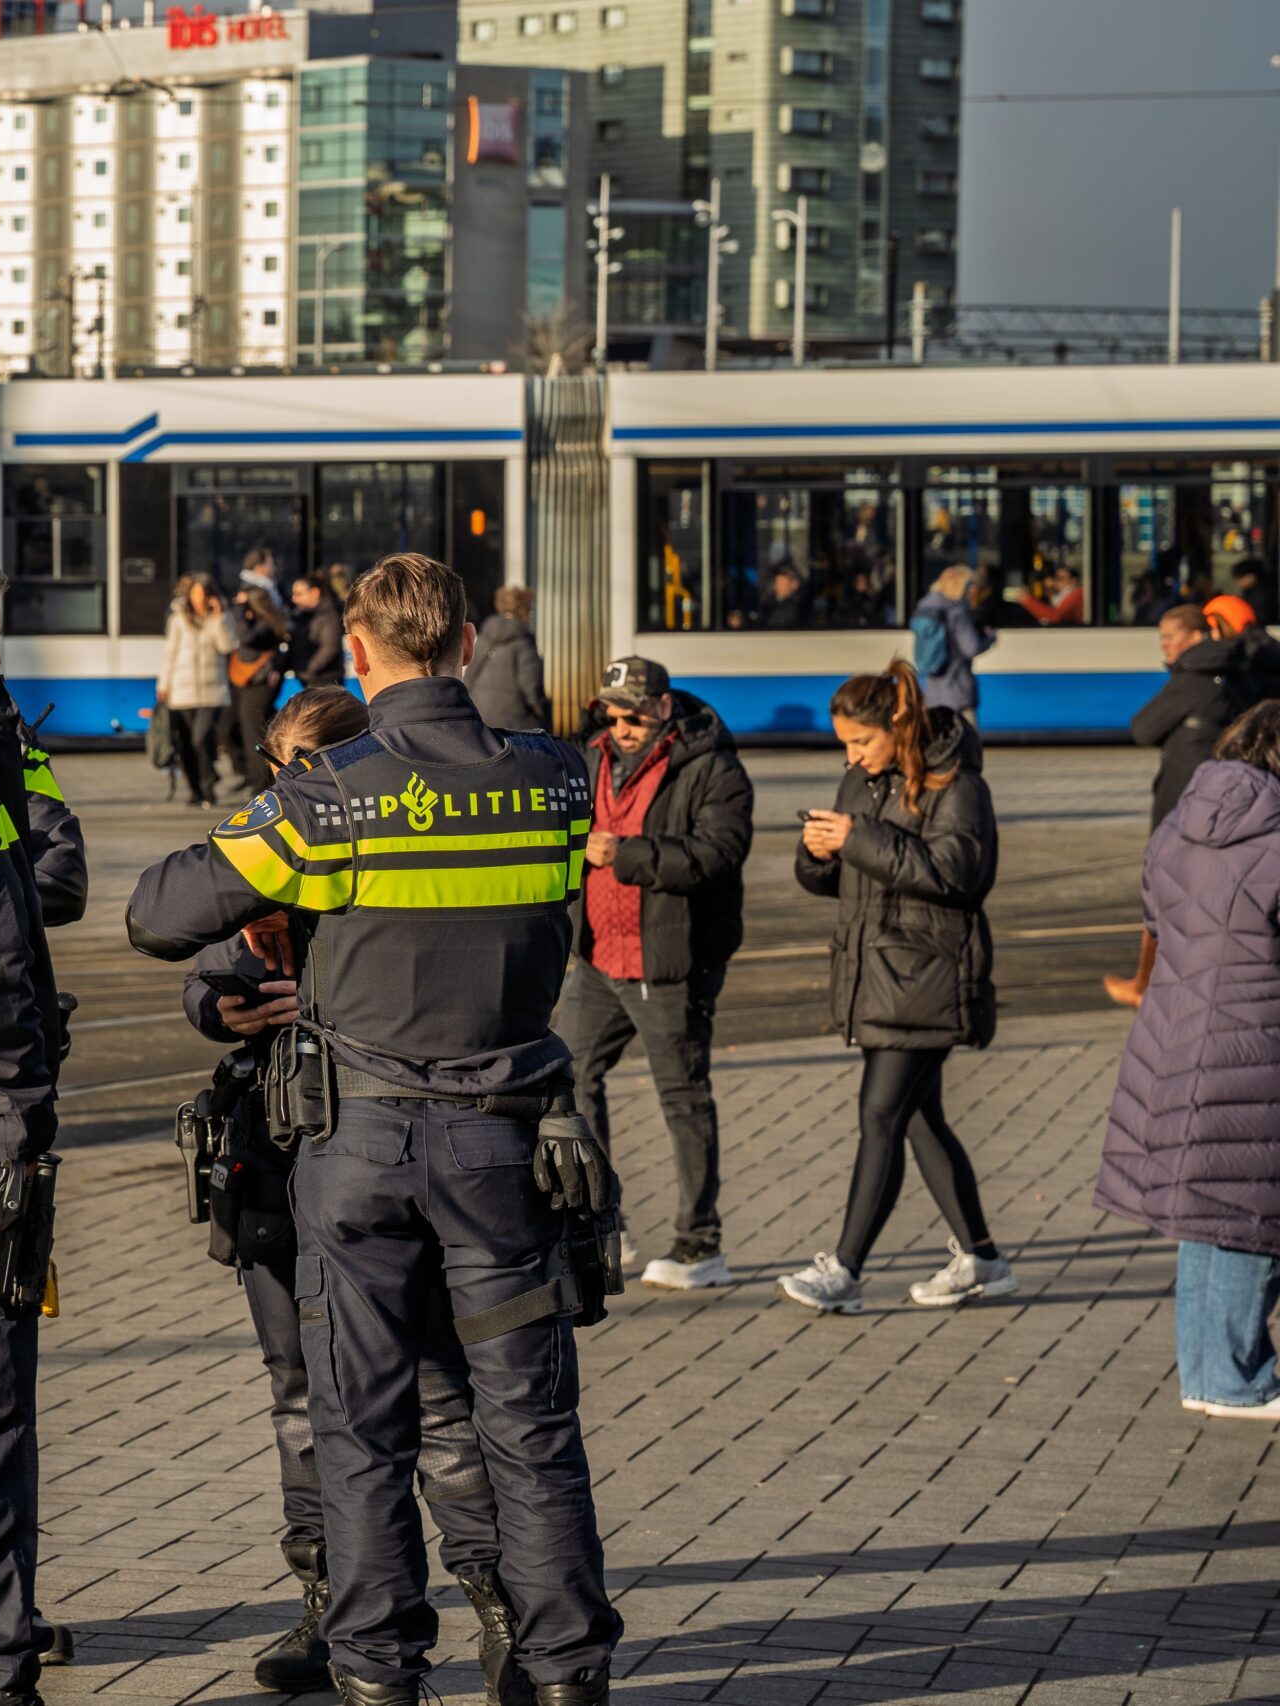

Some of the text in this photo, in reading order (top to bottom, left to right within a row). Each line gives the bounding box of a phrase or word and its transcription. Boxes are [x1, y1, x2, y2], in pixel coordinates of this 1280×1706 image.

[167, 4, 289, 51] ibis HOTEL
[379, 775, 547, 831] POLITIE
[214, 1168, 225, 1185] TQ
